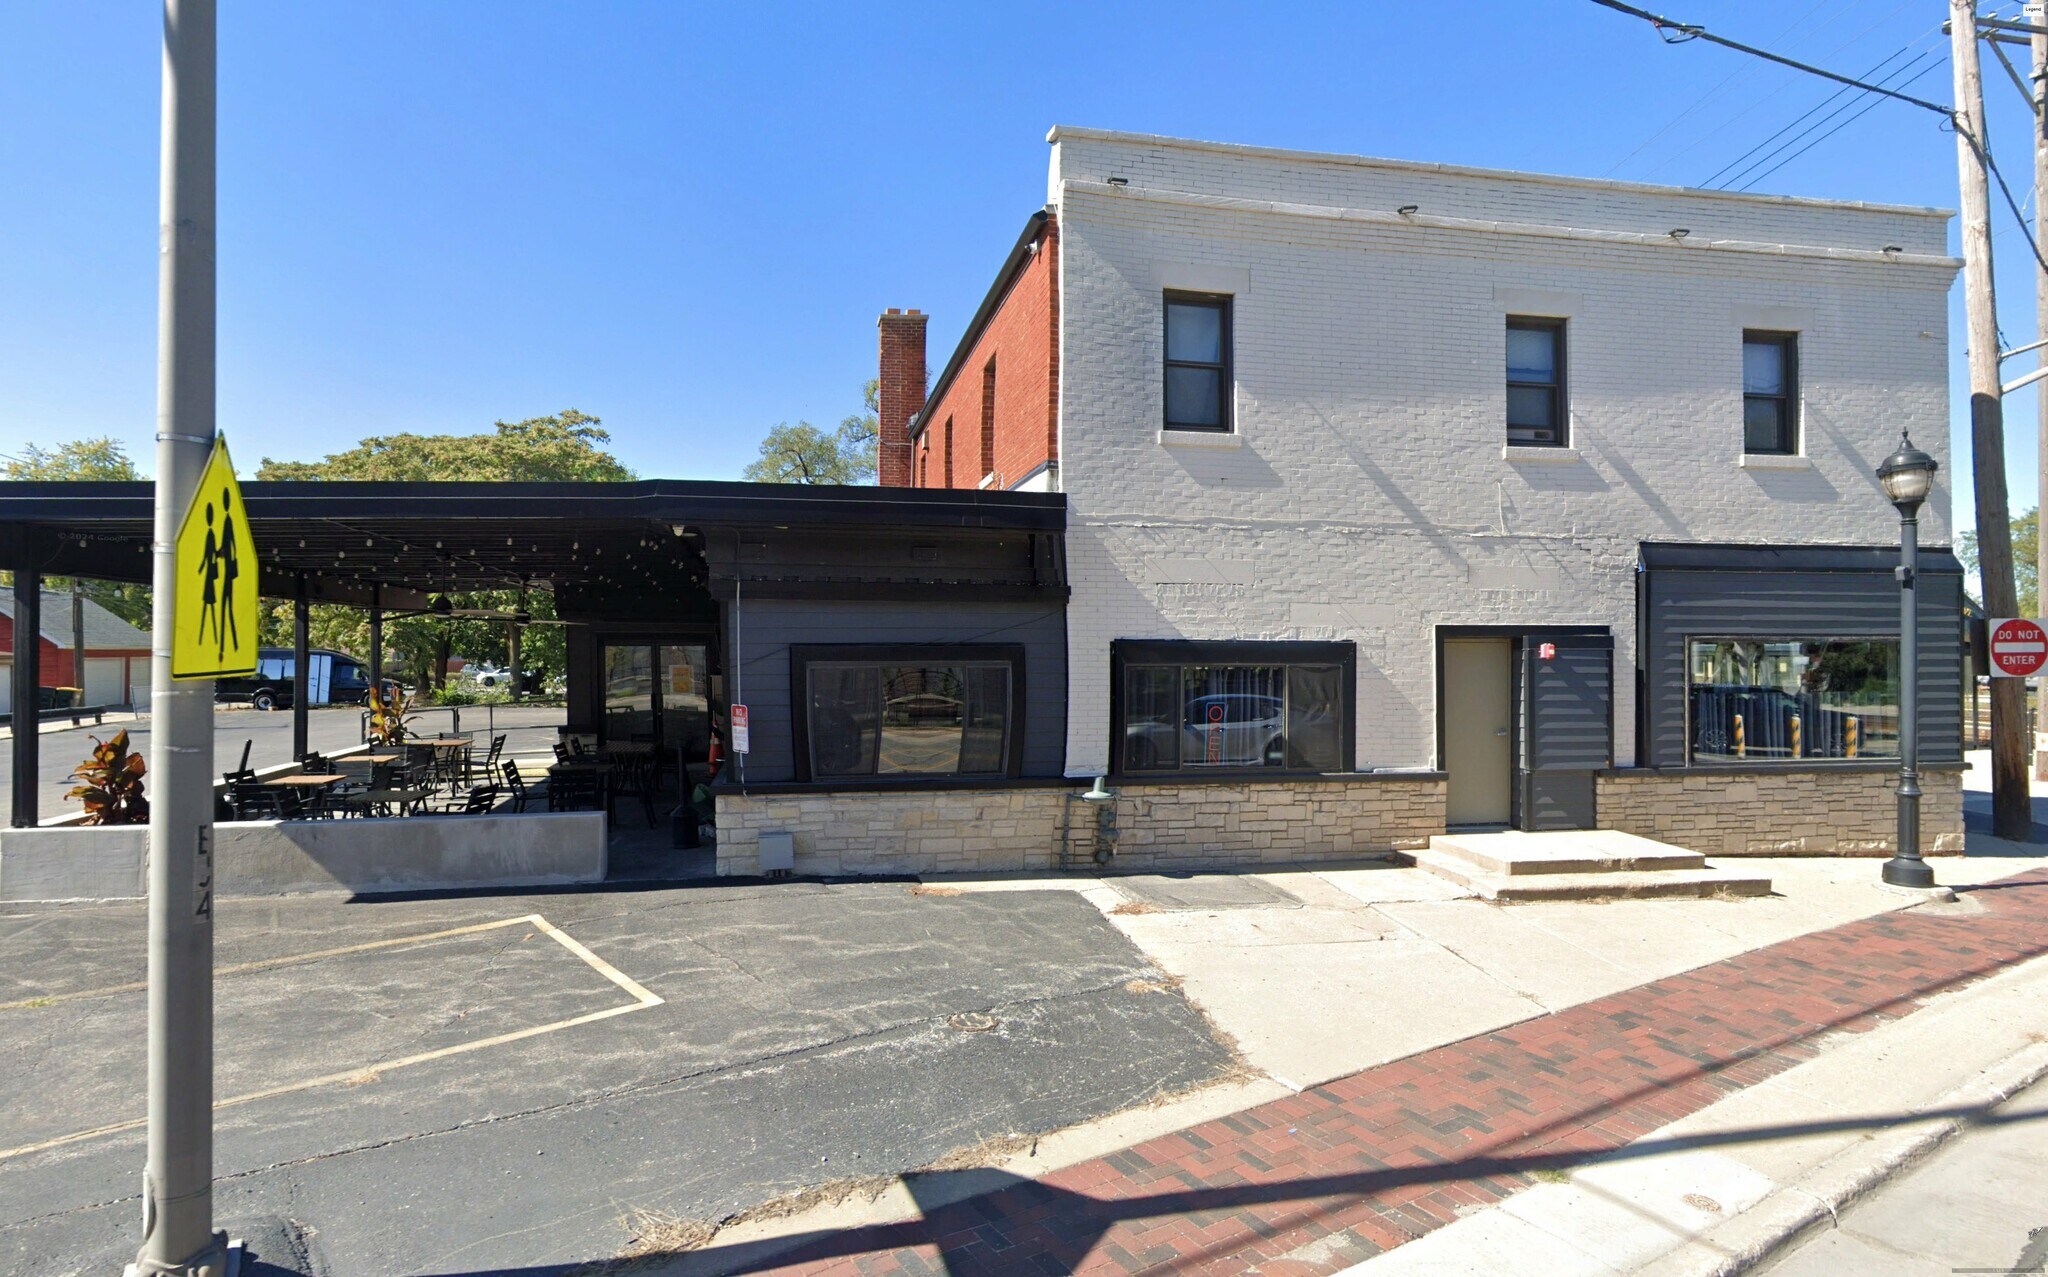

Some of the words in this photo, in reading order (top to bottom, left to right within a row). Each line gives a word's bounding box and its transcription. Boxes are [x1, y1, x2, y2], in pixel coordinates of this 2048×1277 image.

[1998, 630, 2012, 640] DO
[2017, 630, 2040, 640] NOT
[2002, 655, 2036, 665] ENTER
